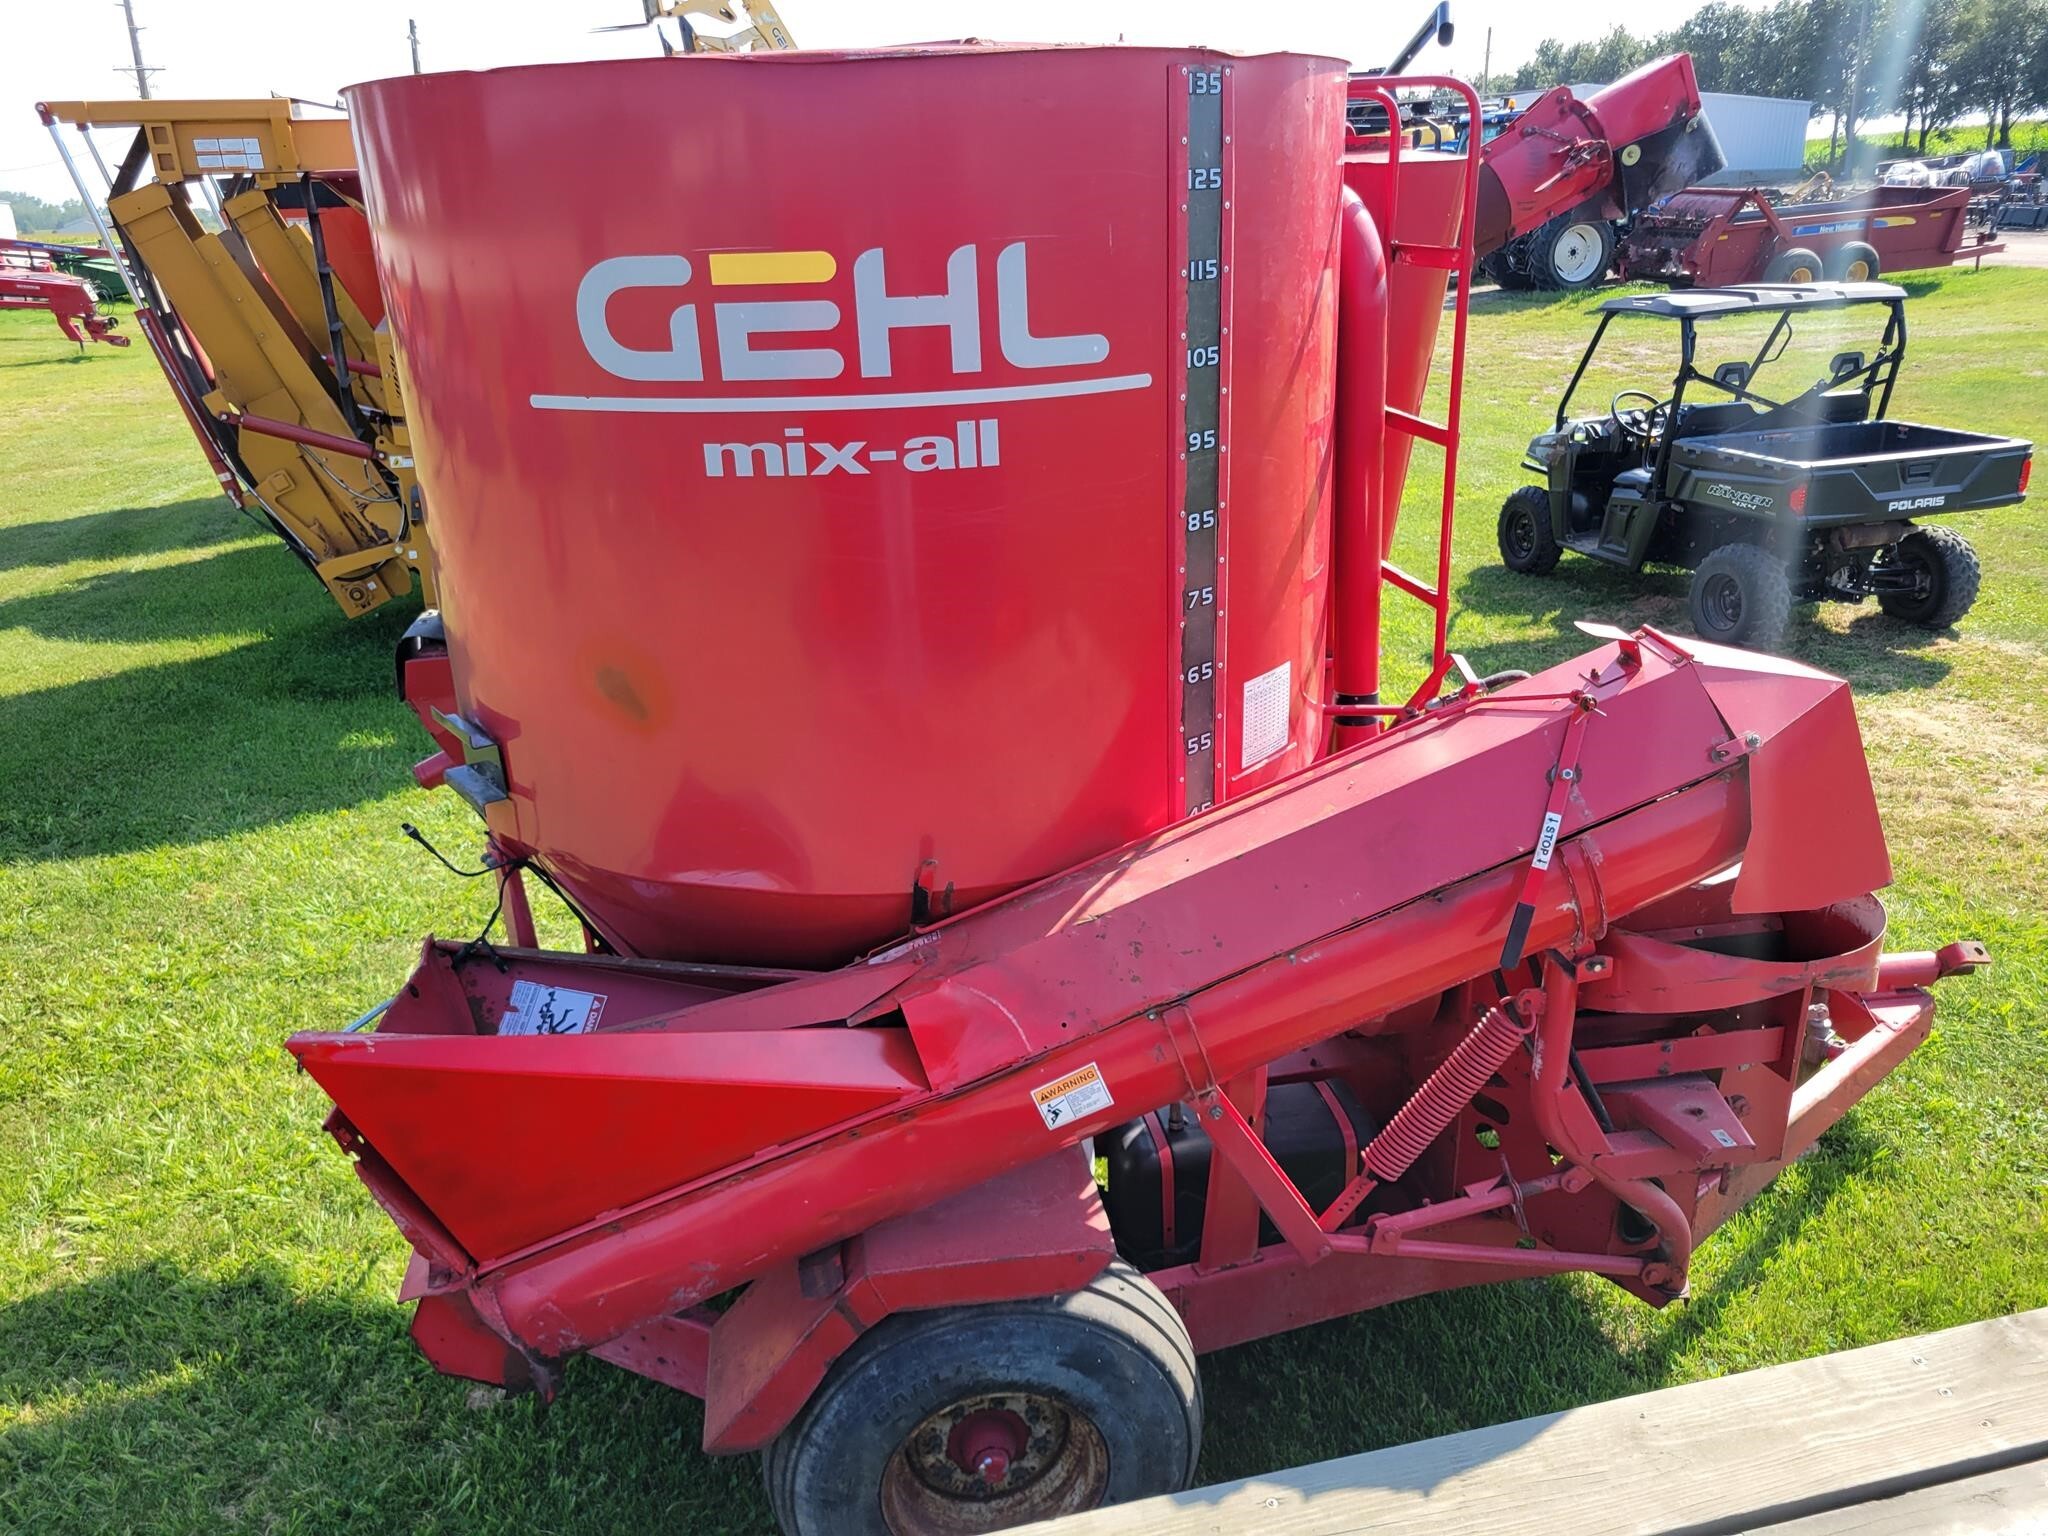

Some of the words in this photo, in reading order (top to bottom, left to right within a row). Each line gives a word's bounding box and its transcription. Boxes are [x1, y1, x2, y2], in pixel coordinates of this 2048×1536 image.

[772, 27, 788, 48] GE
[1188, 72, 1222, 95] 135
[1187, 168, 1222, 190] 125
[1190, 259, 1218, 281] 115
[576, 241, 1110, 381] GEHL
[1186, 346, 1219, 369] 105
[703, 418, 1000, 477] mix-all
[1188, 429, 1216, 452] 95
[1706, 485, 1774, 508] RANGER
[1888, 496, 1945, 512] POLARIS
[1187, 510, 1215, 532] 85
[1187, 586, 1214, 609] 75
[1186, 661, 1213, 684] 65
[1186, 732, 1212, 755] 55
[1540, 825, 1556, 856] STOP
[584, 1011, 598, 1034] DAN
[1047, 1070, 1096, 1097] WARNING
